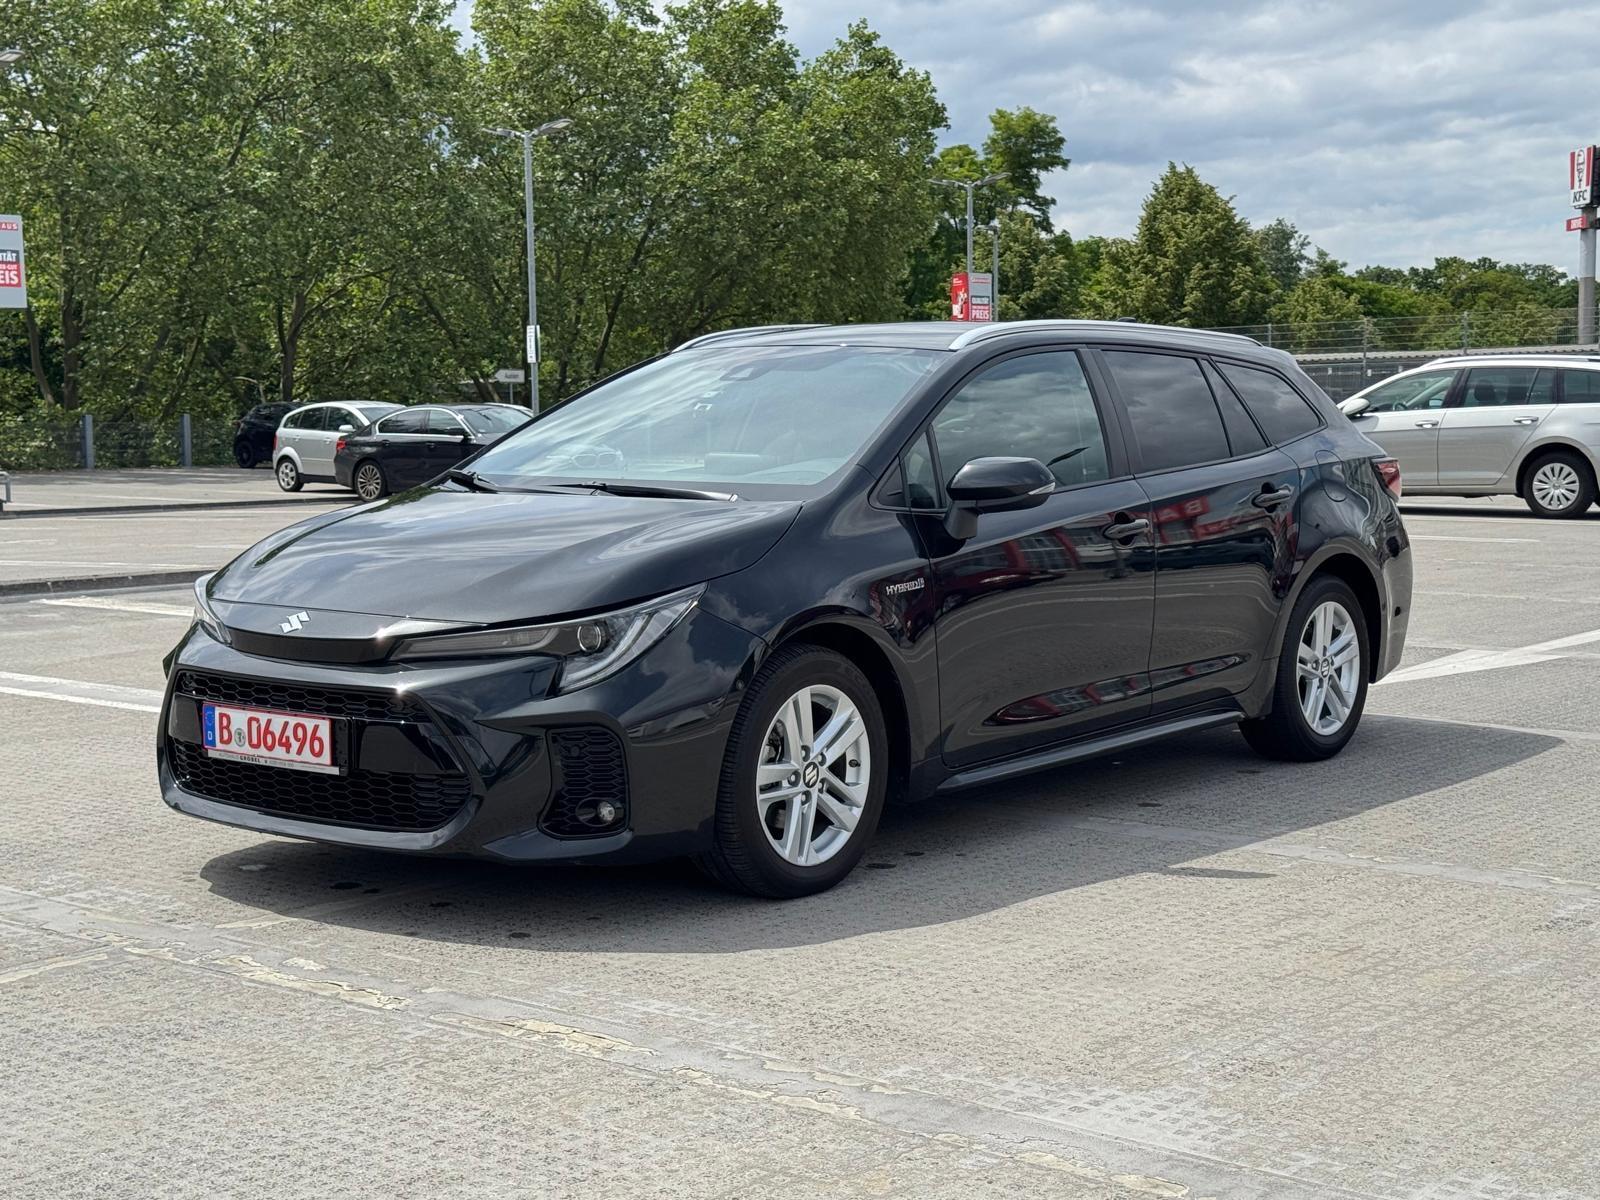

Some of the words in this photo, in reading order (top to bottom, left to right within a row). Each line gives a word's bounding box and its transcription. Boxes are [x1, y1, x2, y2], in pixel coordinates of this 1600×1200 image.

[1573, 190, 1587, 203] KFC
[208, 731, 212, 740] D
[218, 712, 233, 746] B
[247, 716, 325, 758] 06496
